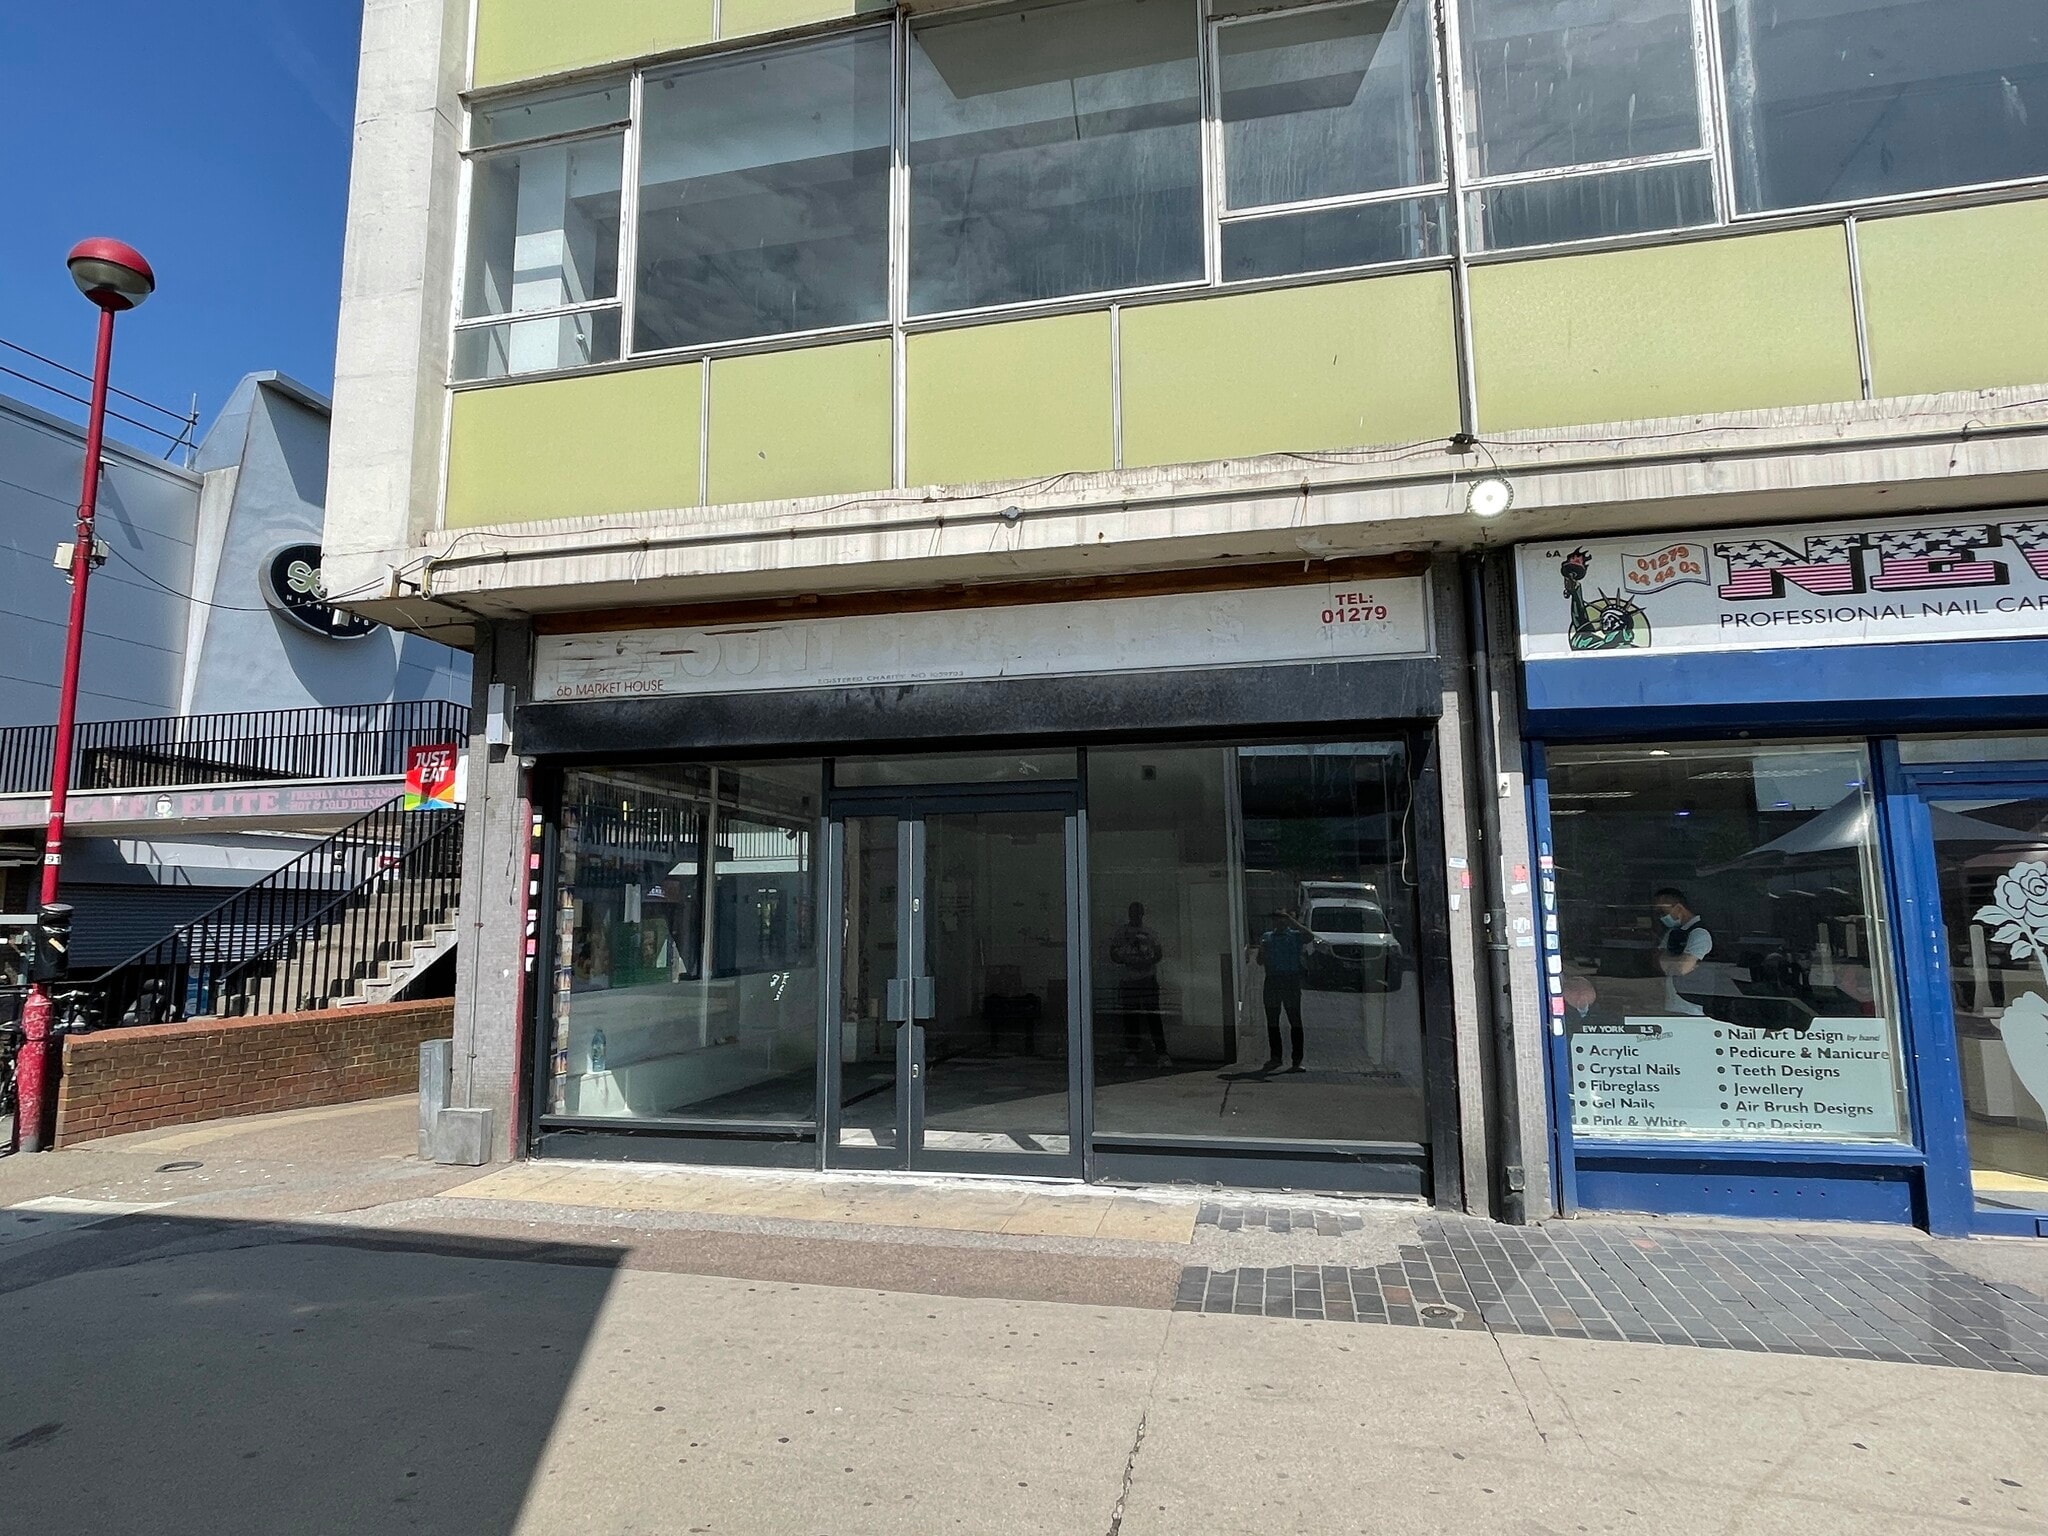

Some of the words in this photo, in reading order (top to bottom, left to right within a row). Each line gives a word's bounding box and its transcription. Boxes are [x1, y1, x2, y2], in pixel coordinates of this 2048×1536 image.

[1546, 550, 1561, 558] 6A
[1714, 519, 2048, 601] NE
[1335, 593, 1373, 606] TEL:
[1321, 605, 1387, 624] 01279
[1720, 603, 1914, 628] PROFESSIONAL
[1922, 599, 1988, 616] NAIL
[556, 685, 572, 697] 6b
[576, 681, 621, 696] MARKET
[624, 679, 664, 692] HOUSE
[414, 750, 449, 771] JUST
[420, 766, 449, 783] EAT
[182, 790, 280, 814] ELITE
[291, 789, 335, 801] FRESHLY
[337, 788, 365, 799] MADE
[323, 799, 348, 810] COLD
[47, 855, 61, 863] 91
[1600, 1025, 1625, 1033] YORK
[1728, 1029, 1757, 1041] Nail
[1763, 1029, 1789, 1041] Art
[1794, 1029, 1843, 1044] Design
[1847, 1034, 1856, 1042] by
[1589, 1045, 1640, 1060] Acrylic
[1729, 1046, 1796, 1059] Pedicure
[1800, 1047, 1812, 1059] &
[1817, 1047, 1890, 1060] Manicure
[1590, 1063, 1641, 1078] Crystal
[1646, 1063, 1681, 1076] Nails
[1731, 1064, 1777, 1077] Teeth
[1781, 1065, 1840, 1081] Designs
[1590, 1080, 1661, 1095] Fibreglass
[1734, 1082, 1804, 1098] Jewellery
[1592, 1098, 1616, 1109] Gel
[1620, 1098, 1655, 1109] Nails
[1735, 1101, 1760, 1112] Air
[1764, 1101, 1809, 1114] Brush
[1813, 1102, 1874, 1118] Designs
[1593, 1115, 1623, 1127] Pink
[1628, 1116, 1639, 1127] &
[1643, 1115, 1688, 1128] White
